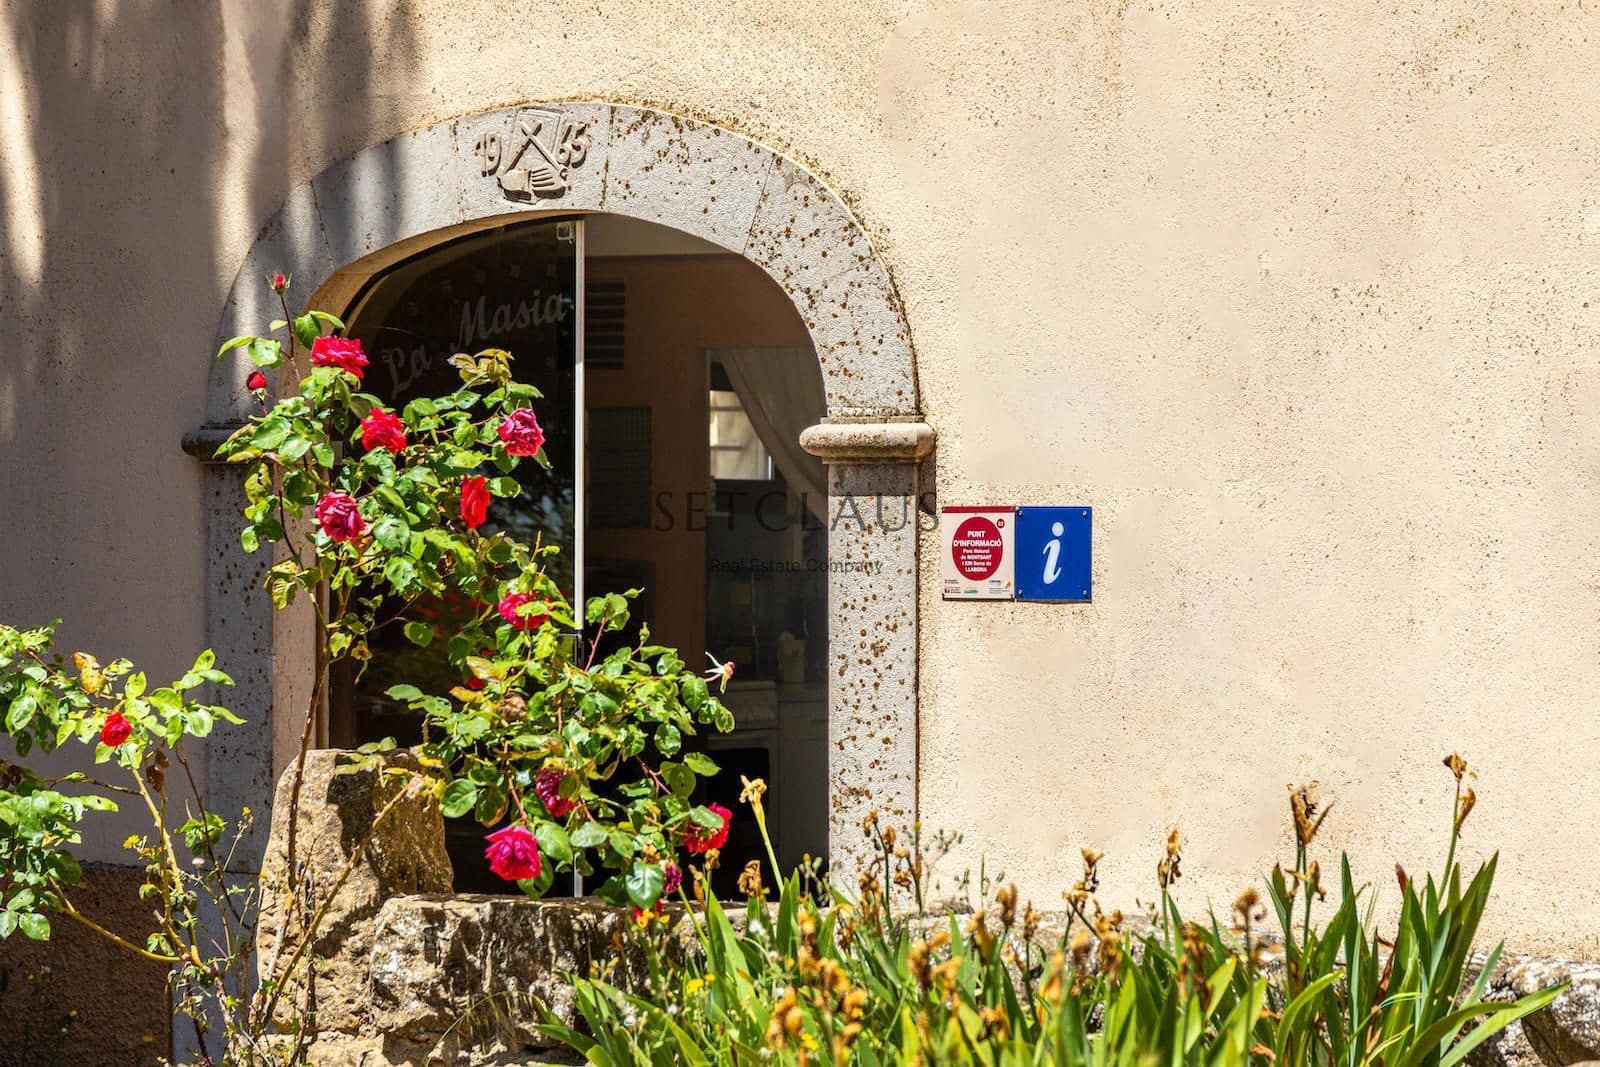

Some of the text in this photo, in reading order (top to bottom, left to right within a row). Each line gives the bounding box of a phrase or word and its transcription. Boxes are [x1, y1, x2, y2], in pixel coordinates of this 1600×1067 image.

[382, 290, 567, 400] La Masia
[967, 530, 986, 538] PUNT
[953, 538, 1002, 547] D'INFORMACIÓ
